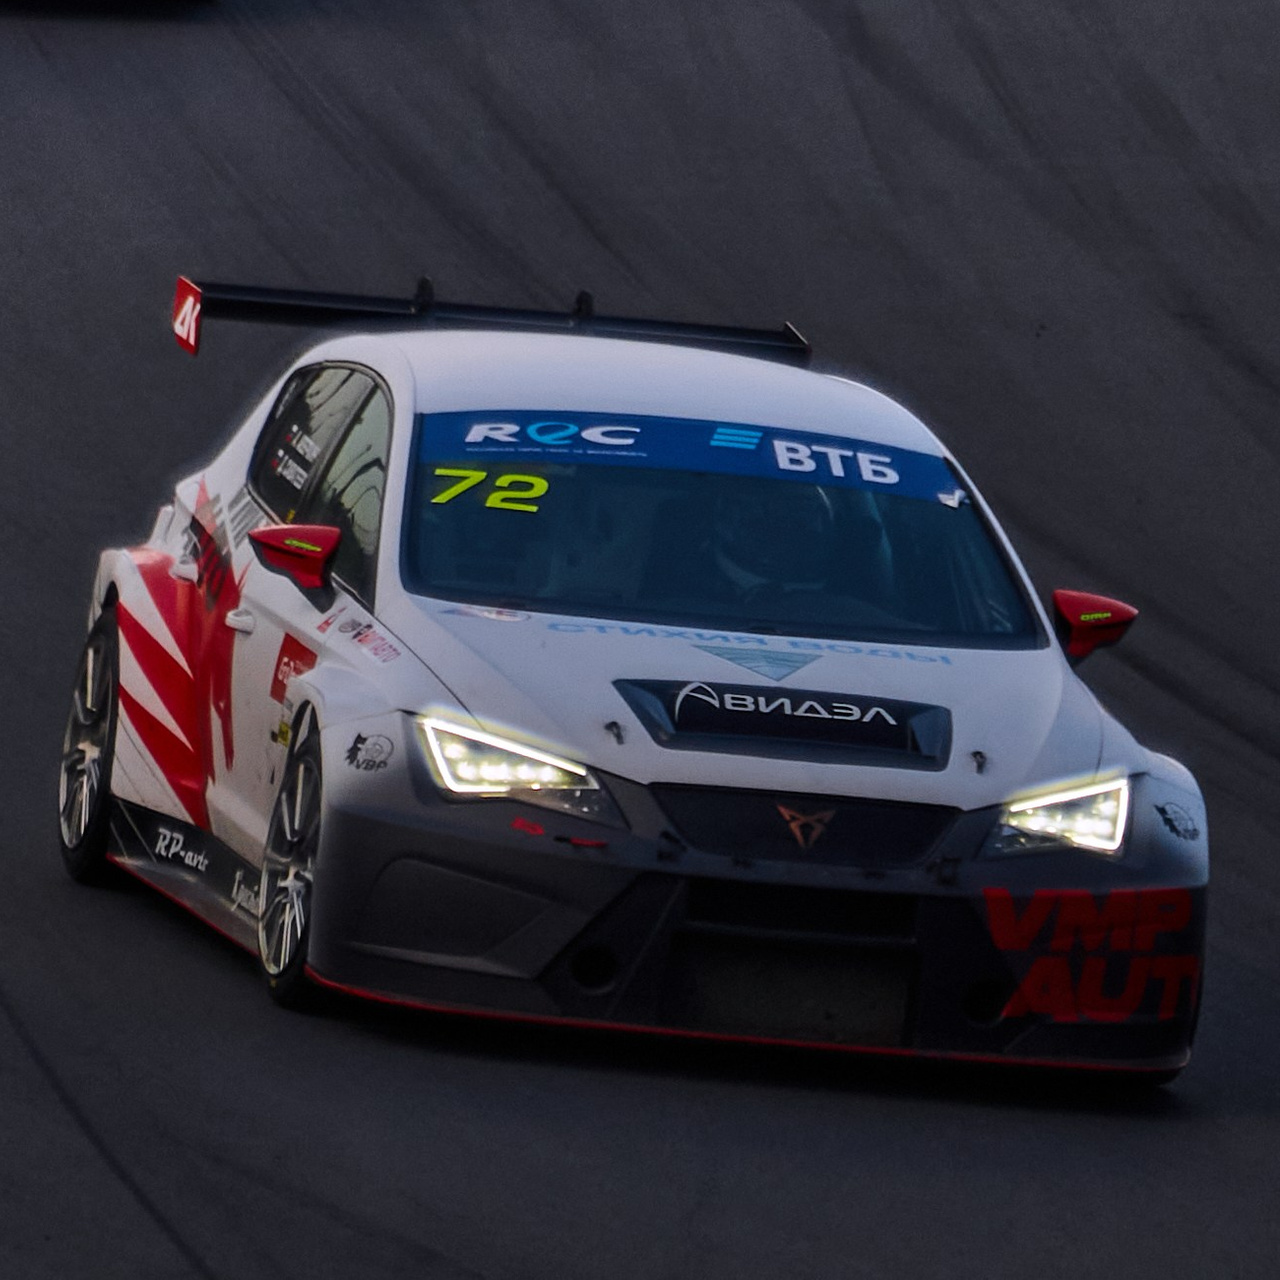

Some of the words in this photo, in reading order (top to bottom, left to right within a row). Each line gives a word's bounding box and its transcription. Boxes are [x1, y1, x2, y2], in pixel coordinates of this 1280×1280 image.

[772, 440, 900, 485] ВТБ
[430, 468, 549, 513] 72
[1001, 955, 1202, 1023] AUT
